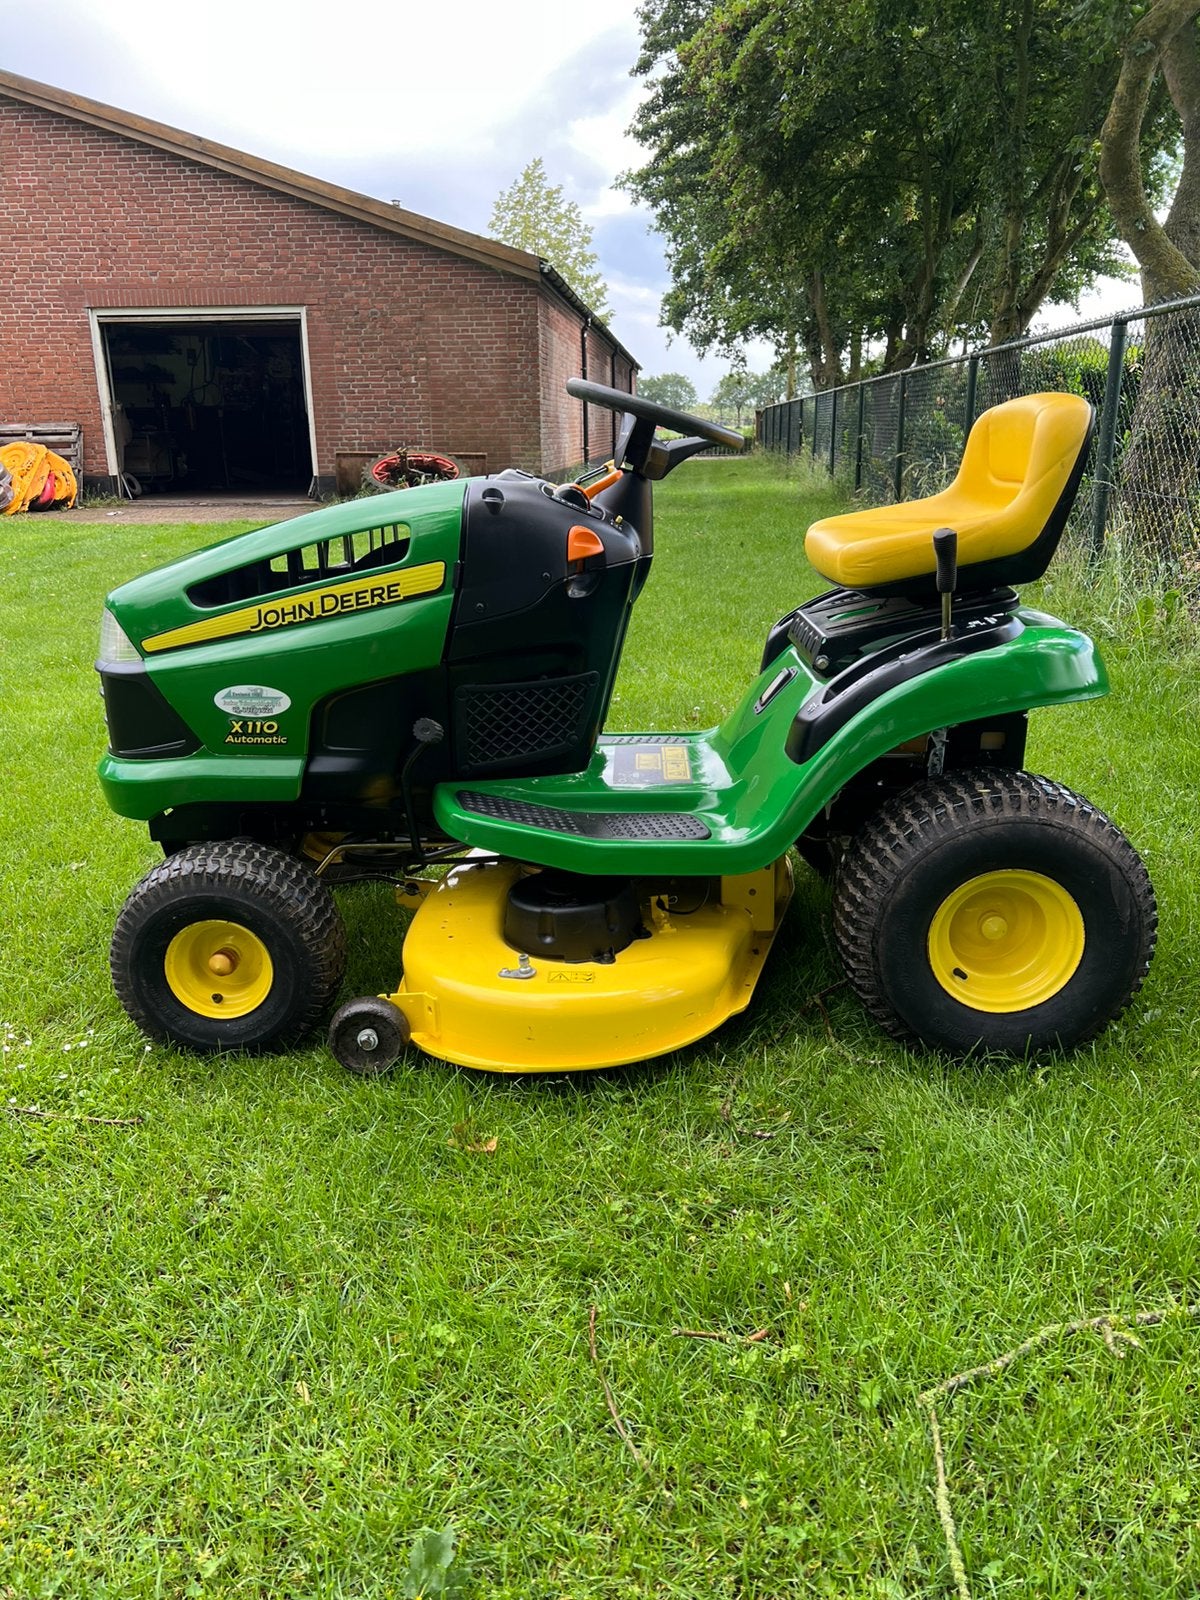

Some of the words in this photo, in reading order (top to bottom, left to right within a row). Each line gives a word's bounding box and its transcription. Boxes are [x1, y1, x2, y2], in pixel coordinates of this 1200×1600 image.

[250, 601, 315, 630] JOHN
[320, 582, 402, 614] DEERE
[230, 720, 279, 734] X110
[224, 734, 288, 745] Automatic
